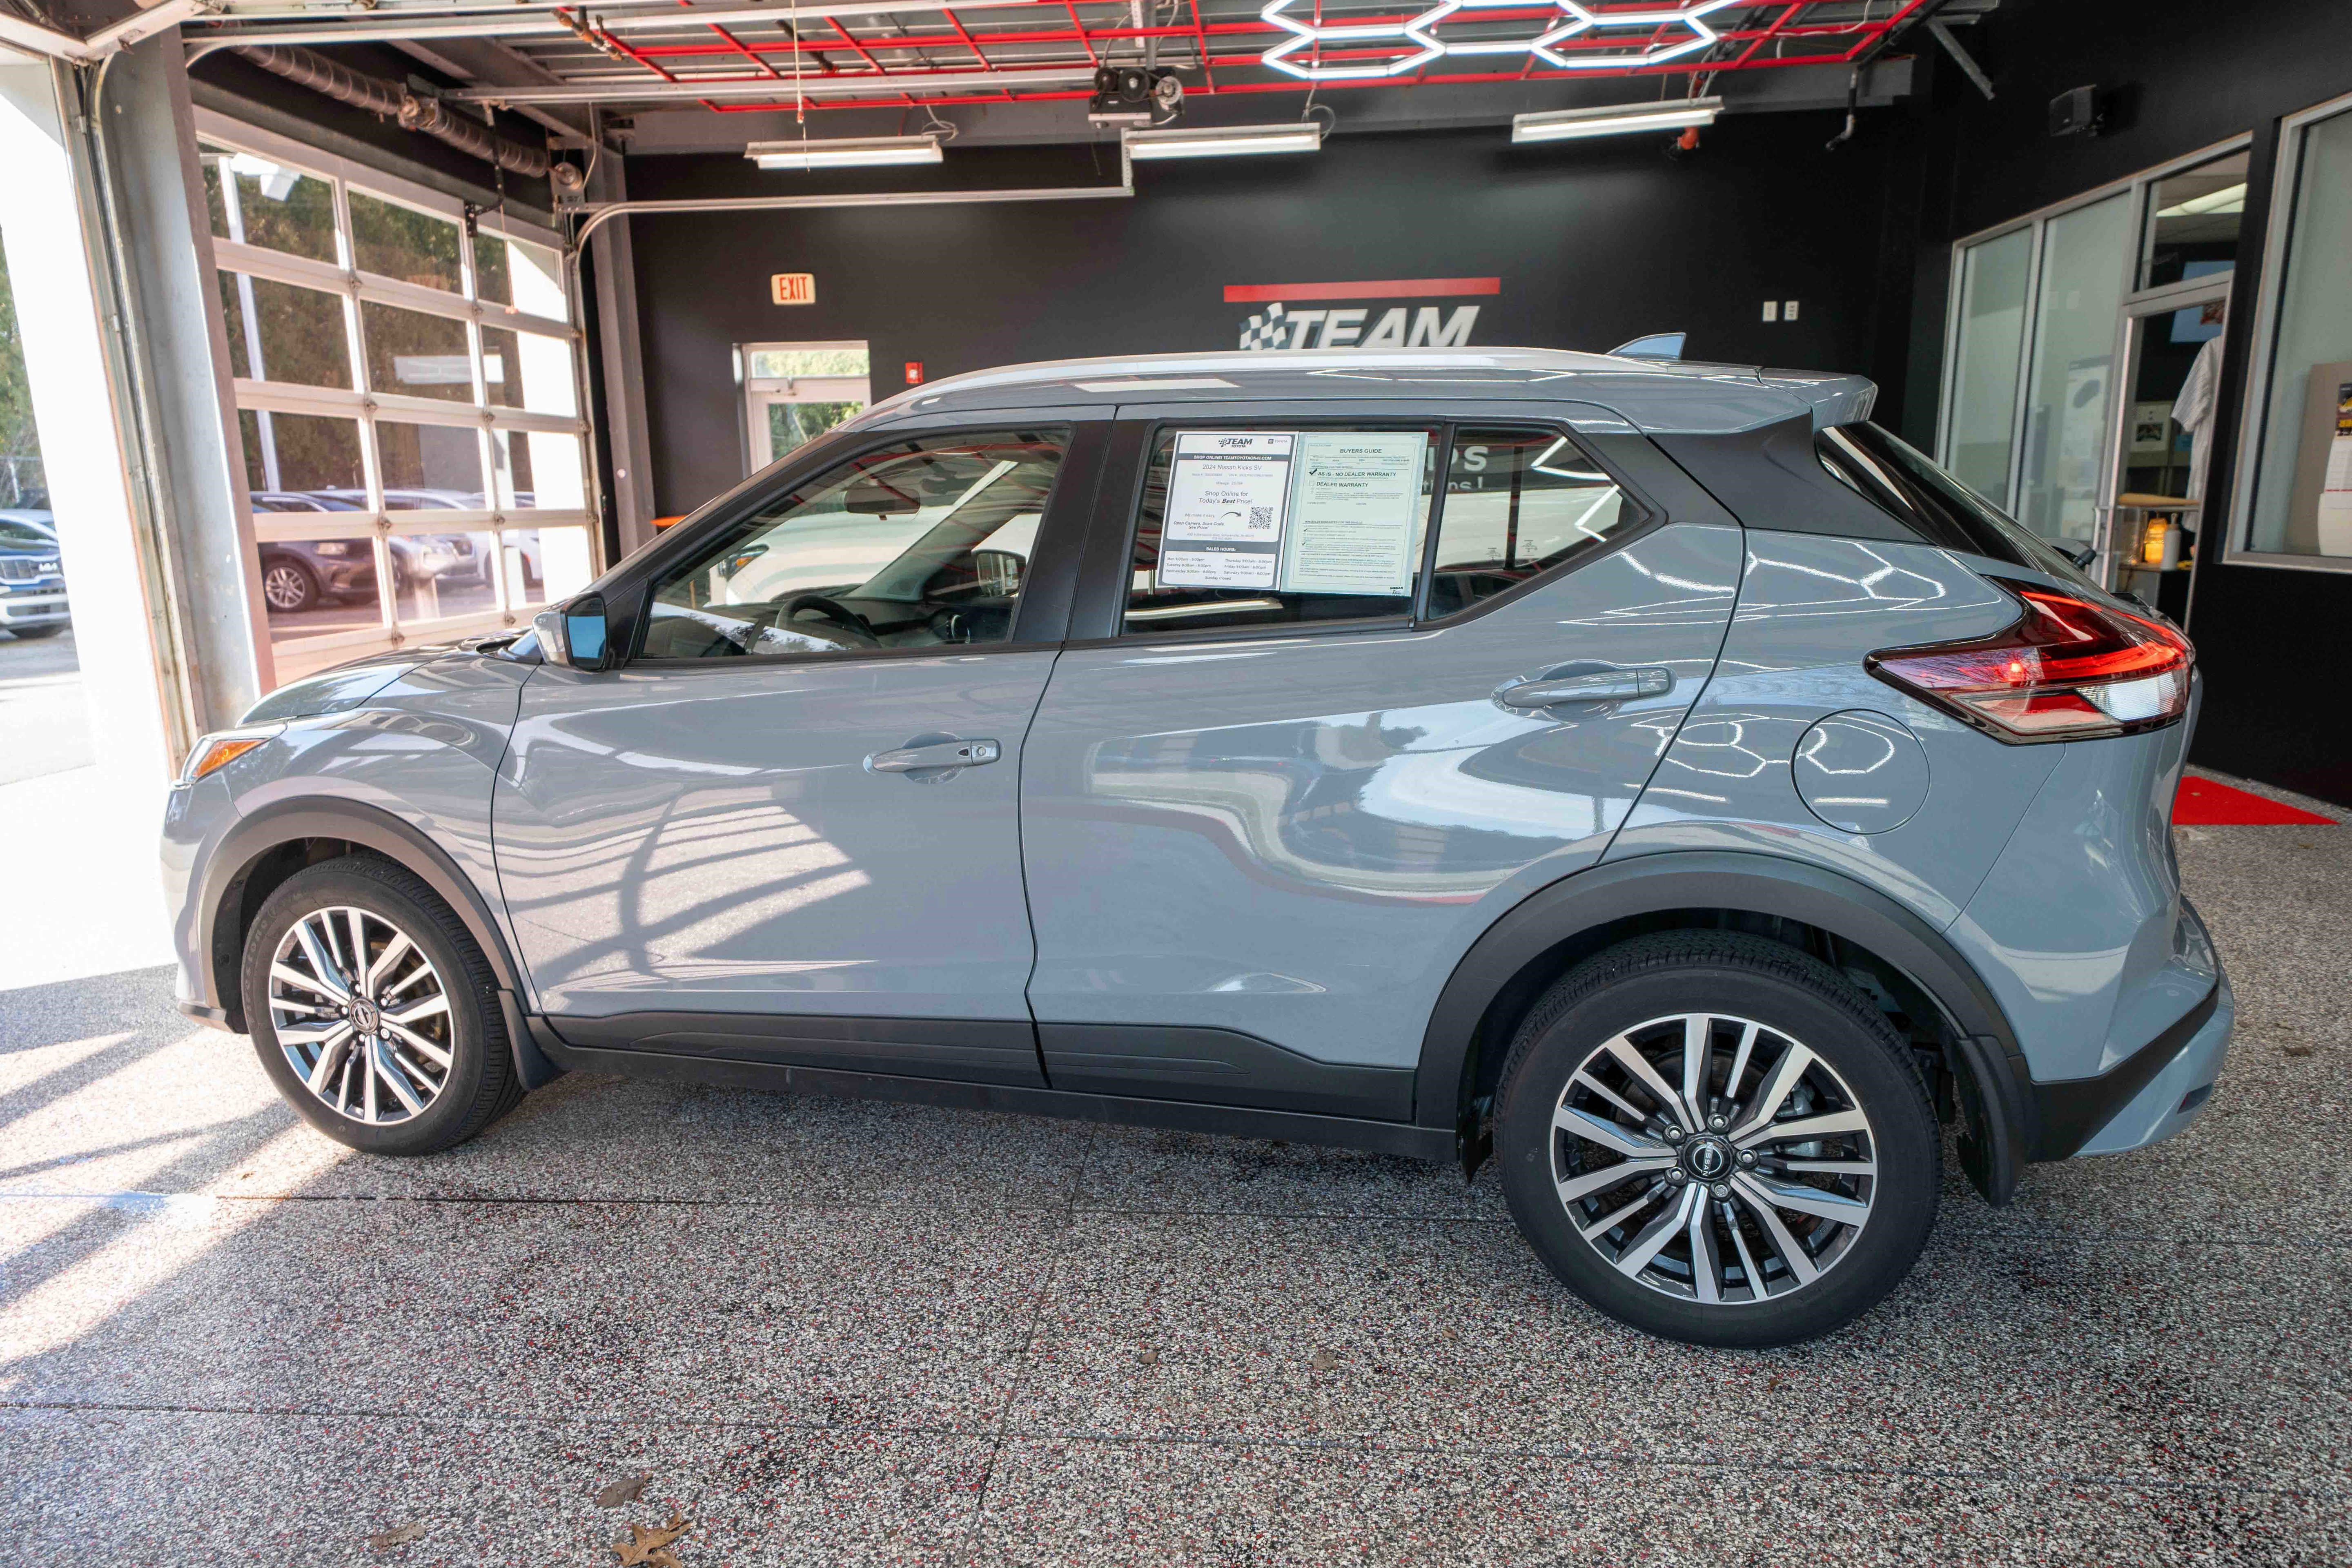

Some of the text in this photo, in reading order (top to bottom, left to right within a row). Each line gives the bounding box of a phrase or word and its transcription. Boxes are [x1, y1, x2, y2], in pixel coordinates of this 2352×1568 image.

[779, 277, 807, 300] EXIT
[1285, 305, 1481, 348] TEAM
[1702, 1142, 1713, 1176] NISSAN
